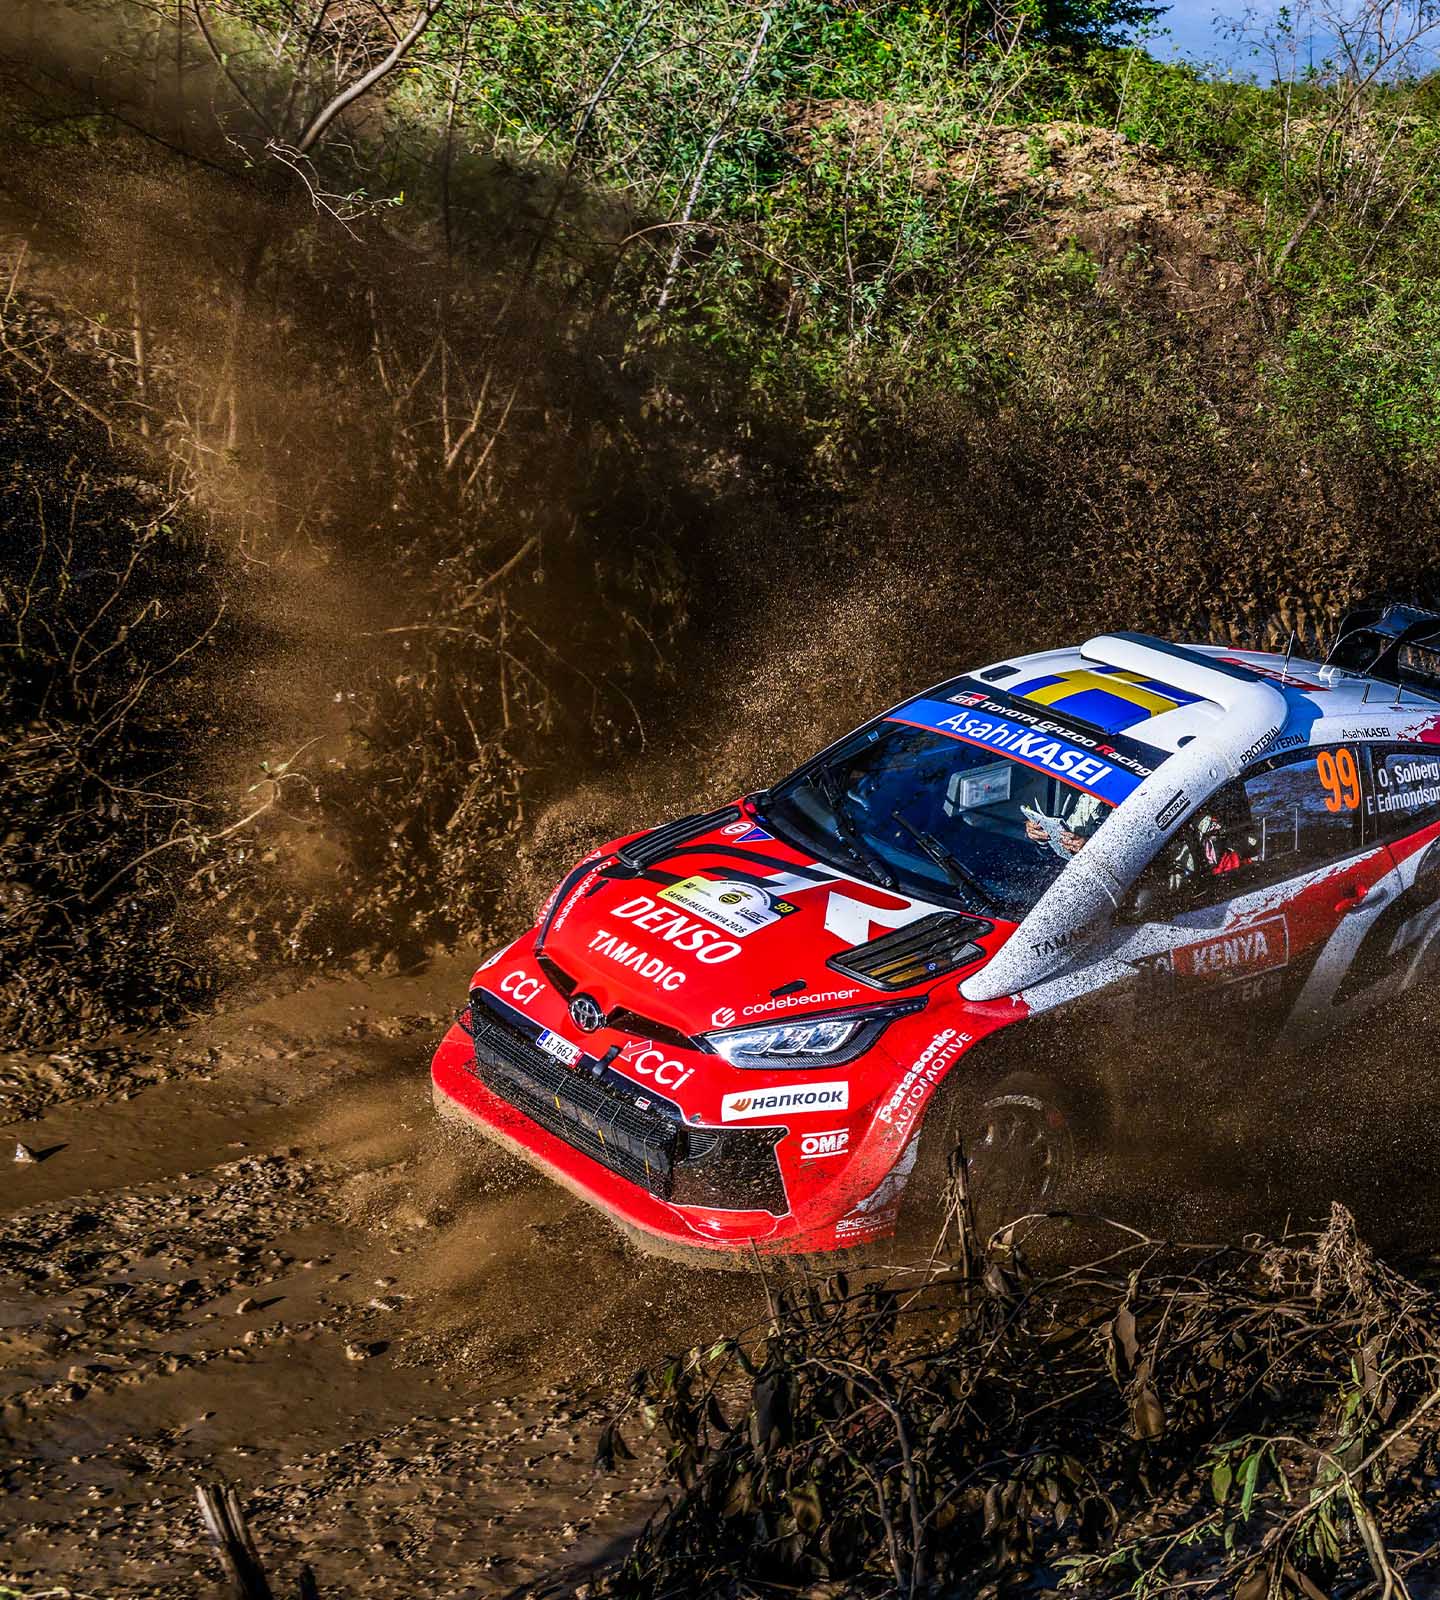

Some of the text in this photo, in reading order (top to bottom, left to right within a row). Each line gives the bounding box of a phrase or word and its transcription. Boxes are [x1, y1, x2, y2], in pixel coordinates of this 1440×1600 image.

[980, 701, 1036, 723] TOYOTA
[1039, 721, 1098, 747] GAZOO
[1095, 745, 1153, 776] Racing
[1240, 726, 1281, 765] PROTERIAL
[1317, 748, 1361, 813] 99
[1378, 761, 1440, 788] O. Solberg
[609, 896, 742, 964] DENSO
[665, 890, 690, 905] SAFARI
[688, 901, 709, 914] RALLY
[706, 908, 728, 925] KENYA
[725, 920, 747, 934] 2026
[774, 902, 794, 914] 99
[588, 929, 687, 991] TAMADIC
[1192, 930, 1269, 976] KENYA
[743, 989, 857, 1016] codebeamer
[545, 1036, 574, 1060] A-7662
[879, 1028, 957, 1124] Panasonic
[894, 1032, 973, 1134] AUTOMOTIVE
[801, 1133, 849, 1154] OMP
